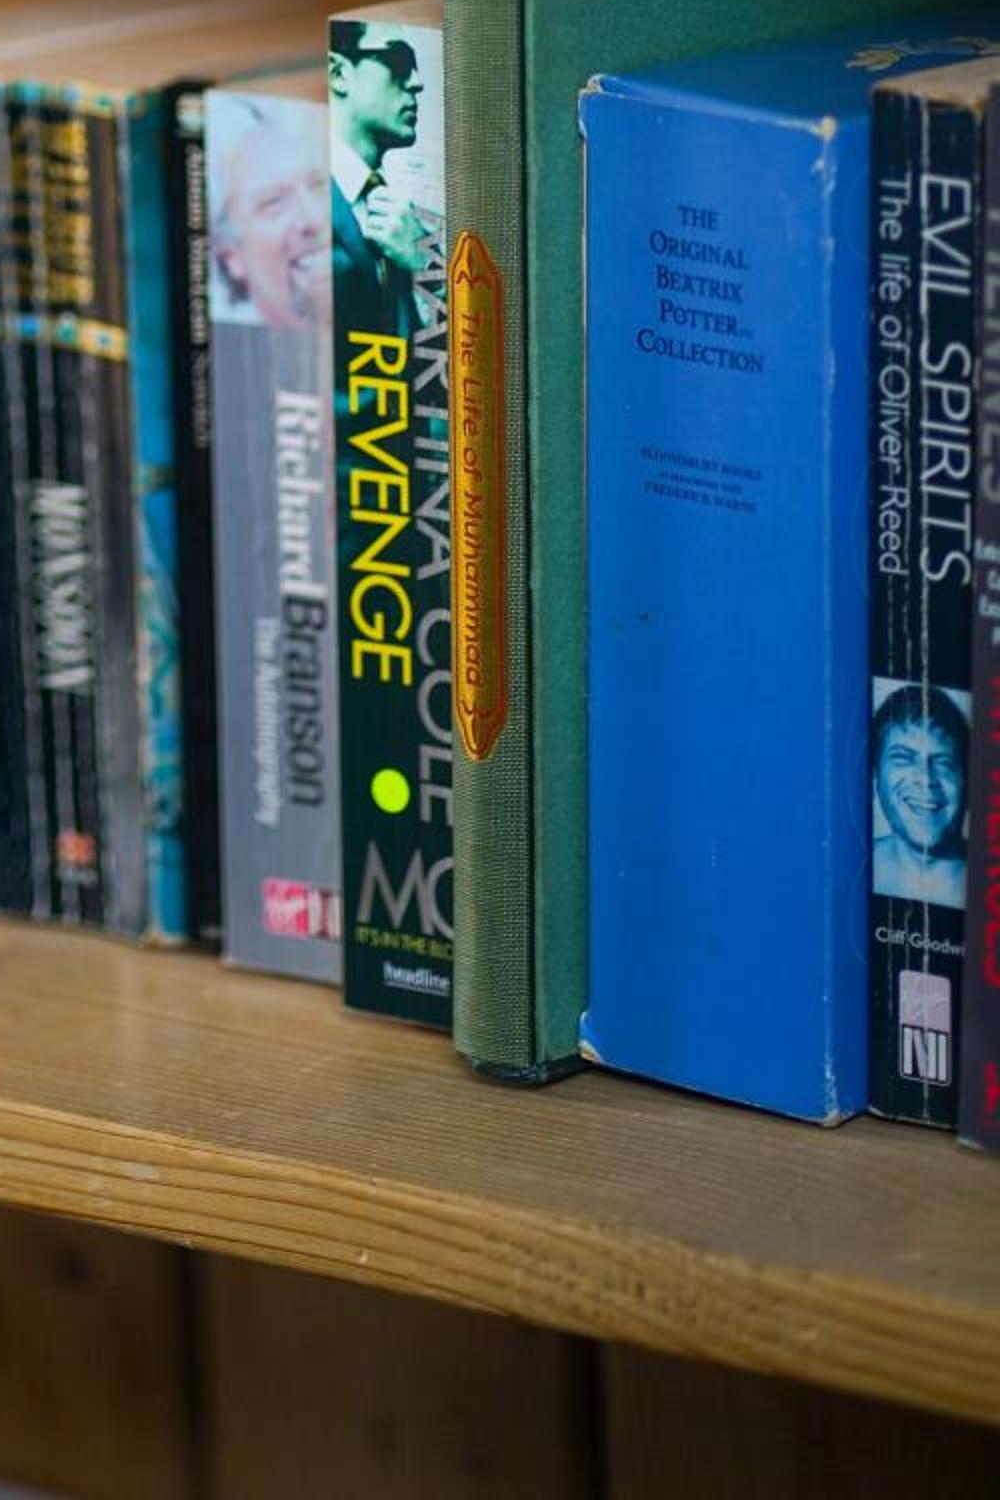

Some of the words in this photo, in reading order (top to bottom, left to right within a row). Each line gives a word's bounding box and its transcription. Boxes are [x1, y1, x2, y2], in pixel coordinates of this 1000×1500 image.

[677, 205, 719, 231] THE
[879, 172, 911, 241] The
[919, 174, 972, 296] EVIL
[649, 230, 749, 270] ORIGINAL
[879, 254, 911, 302] life
[656, 264, 743, 304] BEATRIX
[461, 311, 484, 365] The
[659, 299, 739, 337] POTTER
[879, 314, 911, 354] of
[637, 328, 764, 373] COLLECTION
[461, 377, 485, 436] Life
[879, 364, 911, 475] Oliver
[462, 448, 486, 484] of
[919, 342, 972, 585] SPIRITS
[275, 391, 329, 598] Richard
[348, 331, 414, 686] REVENGE
[879, 484, 912, 575] Reed
[461, 490, 486, 690] Muhammad
[281, 596, 330, 808] Branson
[416, 607, 454, 827] COLE
[874, 927, 906, 946] Cliff
